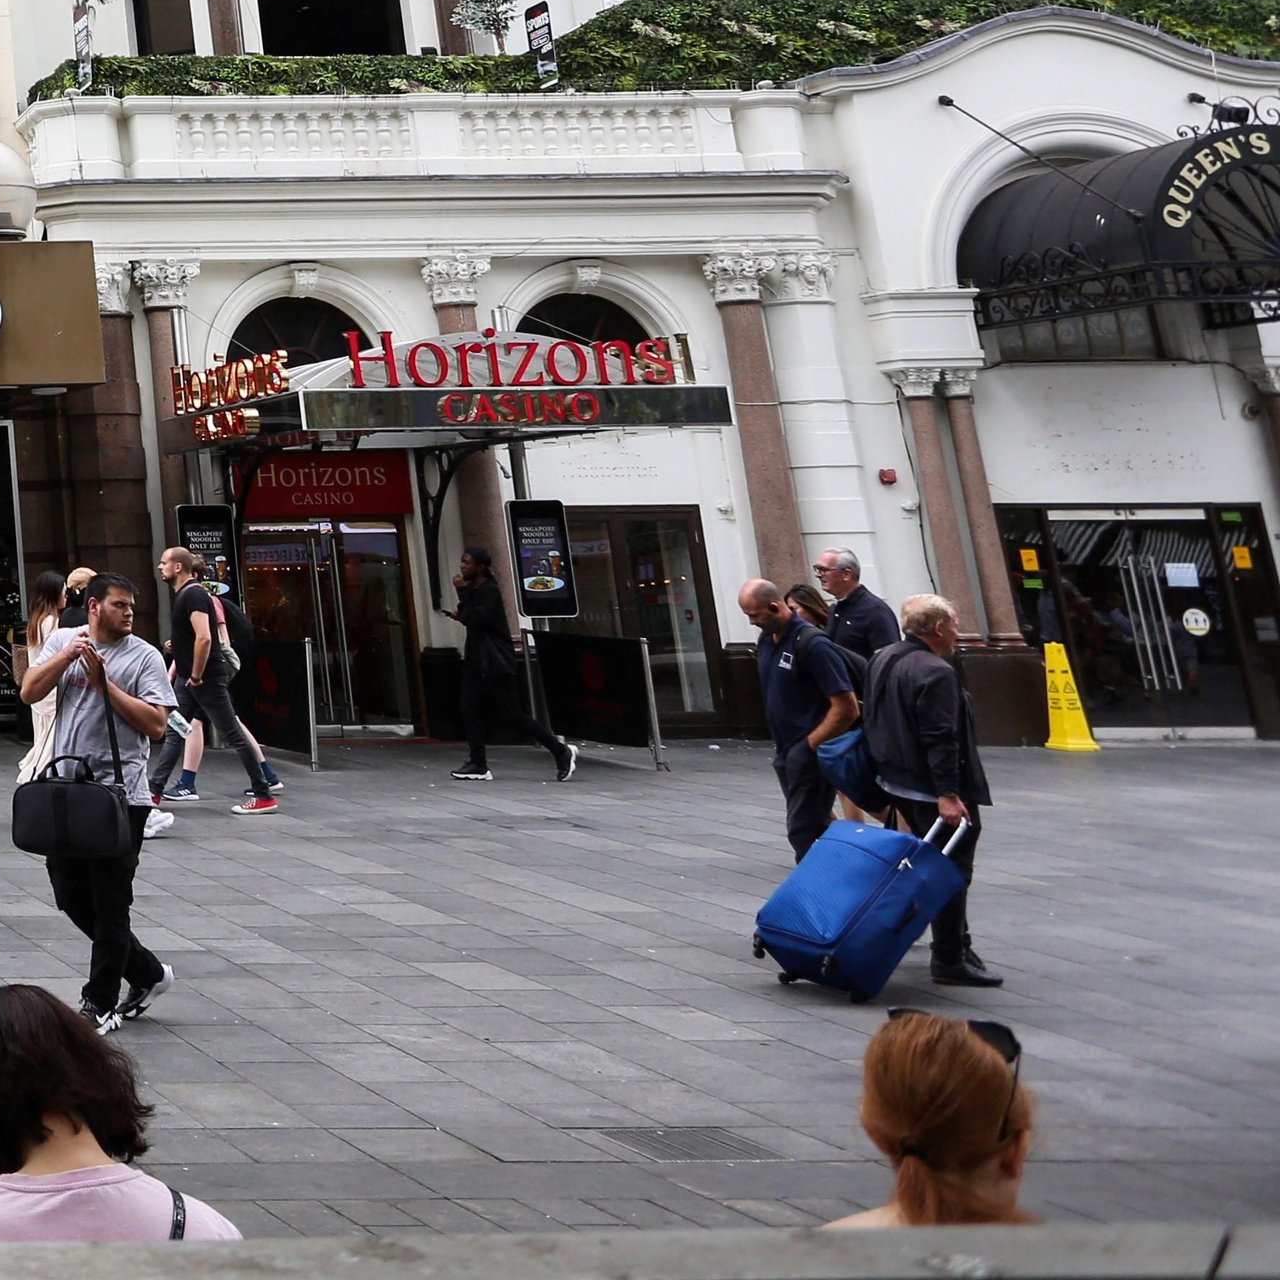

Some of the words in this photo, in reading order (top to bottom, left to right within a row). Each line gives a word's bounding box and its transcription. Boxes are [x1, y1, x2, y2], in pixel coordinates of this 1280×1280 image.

[1162, 132, 1271, 228] QUEEN'S
[342, 327, 676, 388] Horizons
[441, 392, 601, 422] CASINO
[256, 462, 387, 488] Horizons
[291, 491, 354, 506] CASINO
